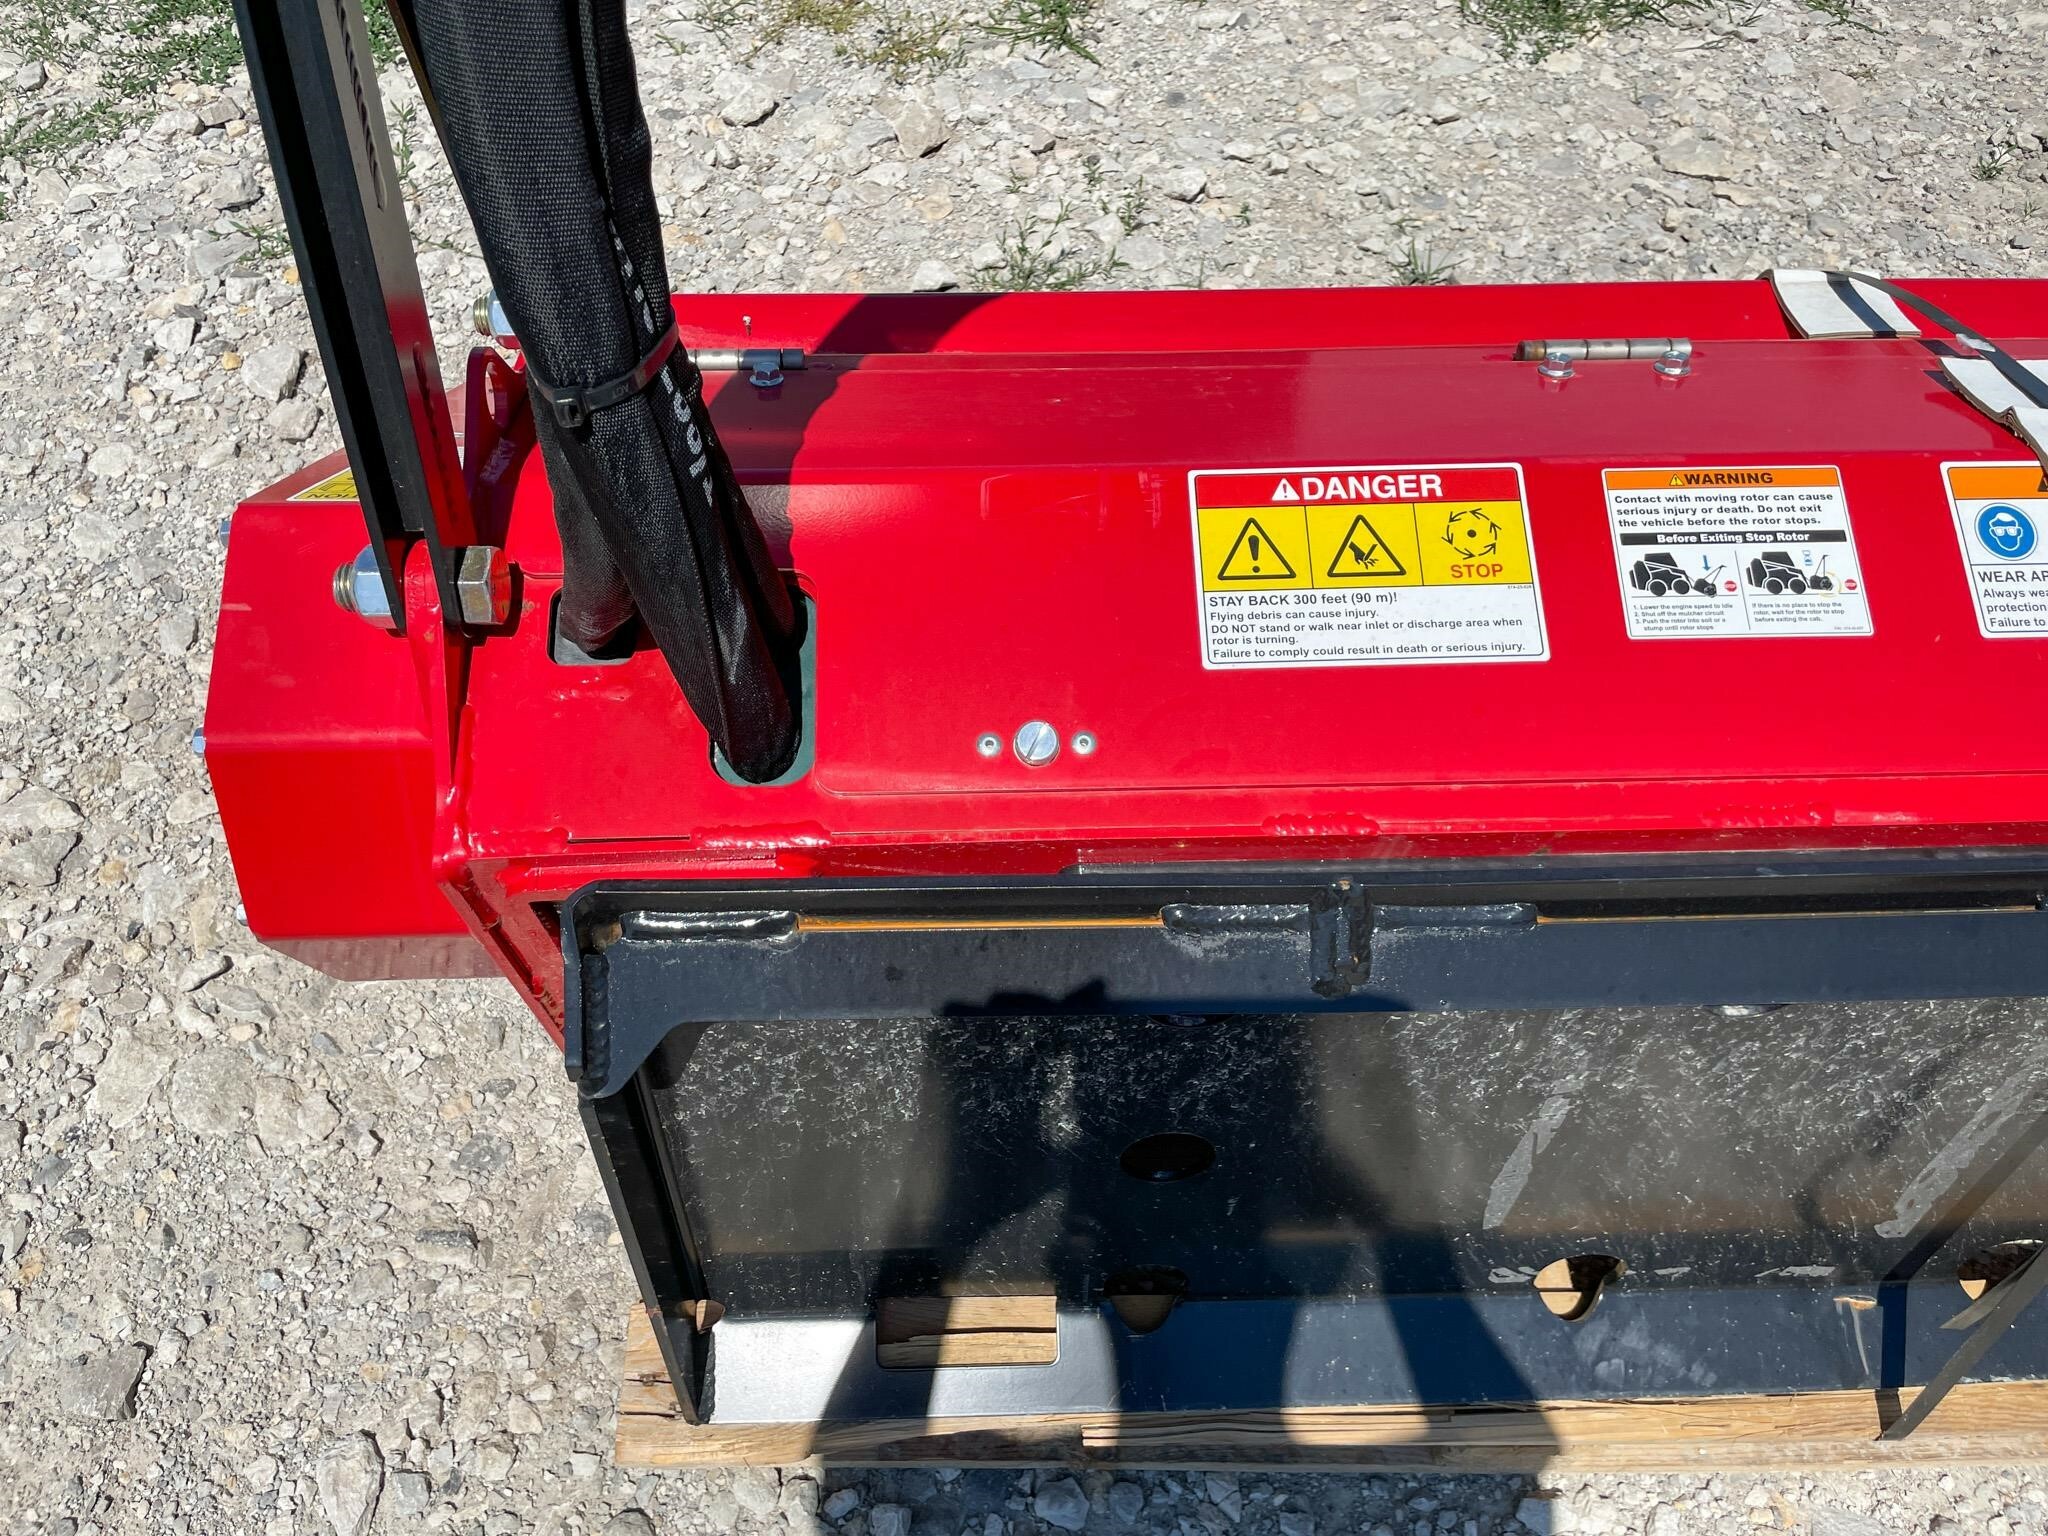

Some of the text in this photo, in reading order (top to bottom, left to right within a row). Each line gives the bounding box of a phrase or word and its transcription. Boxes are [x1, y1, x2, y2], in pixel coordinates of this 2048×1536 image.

[1683, 472, 1774, 485] WARNING
[1302, 474, 1444, 500] DANGER
[1614, 495, 1662, 504] Contact
[1664, 494, 1691, 503] with
[1694, 494, 1737, 504] moving
[1740, 494, 1770, 502] rotor
[1616, 507, 1660, 516] serious
[1663, 506, 1697, 516] injury
[1716, 505, 1754, 514] death.
[1757, 504, 1773, 513] Do
[1776, 504, 1796, 512] not
[1799, 504, 1822, 512] exit
[1618, 516, 1821, 528] the vehicle before the rotor stops.
[1656, 532, 1810, 544] Before Exiting Stop Rotor
[1450, 563, 1504, 579] STOP
[1978, 570, 2028, 583] WEAR
[1209, 596, 1244, 608] STAY
[1248, 594, 1290, 606] BACK
[1294, 594, 1317, 605] 300
[1320, 594, 1348, 604] feet
[1351, 592, 1372, 606] (90
[1983, 588, 2026, 600] Always
[1986, 602, 2047, 614] protection
[1210, 612, 1244, 623] Flying
[1247, 610, 1282, 620] debris
[1308, 610, 1342, 618] cause
[1344, 608, 1379, 619] injury.
[1211, 624, 1229, 634] DO
[1232, 624, 1256, 634] NOT
[1259, 623, 1290, 633] stand
[1308, 622, 1334, 632] walk
[1365, 620, 1390, 630] inlet
[1407, 619, 1462, 629] discharge
[1492, 618, 1522, 626] when
[1989, 617, 2046, 628] Failure to
[1212, 634, 1298, 646] rotor is turning.
[1213, 648, 1252, 658] Failure
[1254, 648, 1266, 657] to
[1268, 647, 1310, 658] comply
[1312, 646, 1344, 656] could
[1347, 644, 1380, 655] result
[1382, 645, 1394, 654] in
[1396, 644, 1428, 654] death
[1446, 642, 1488, 652] serious
[1491, 642, 1526, 653] injury.
